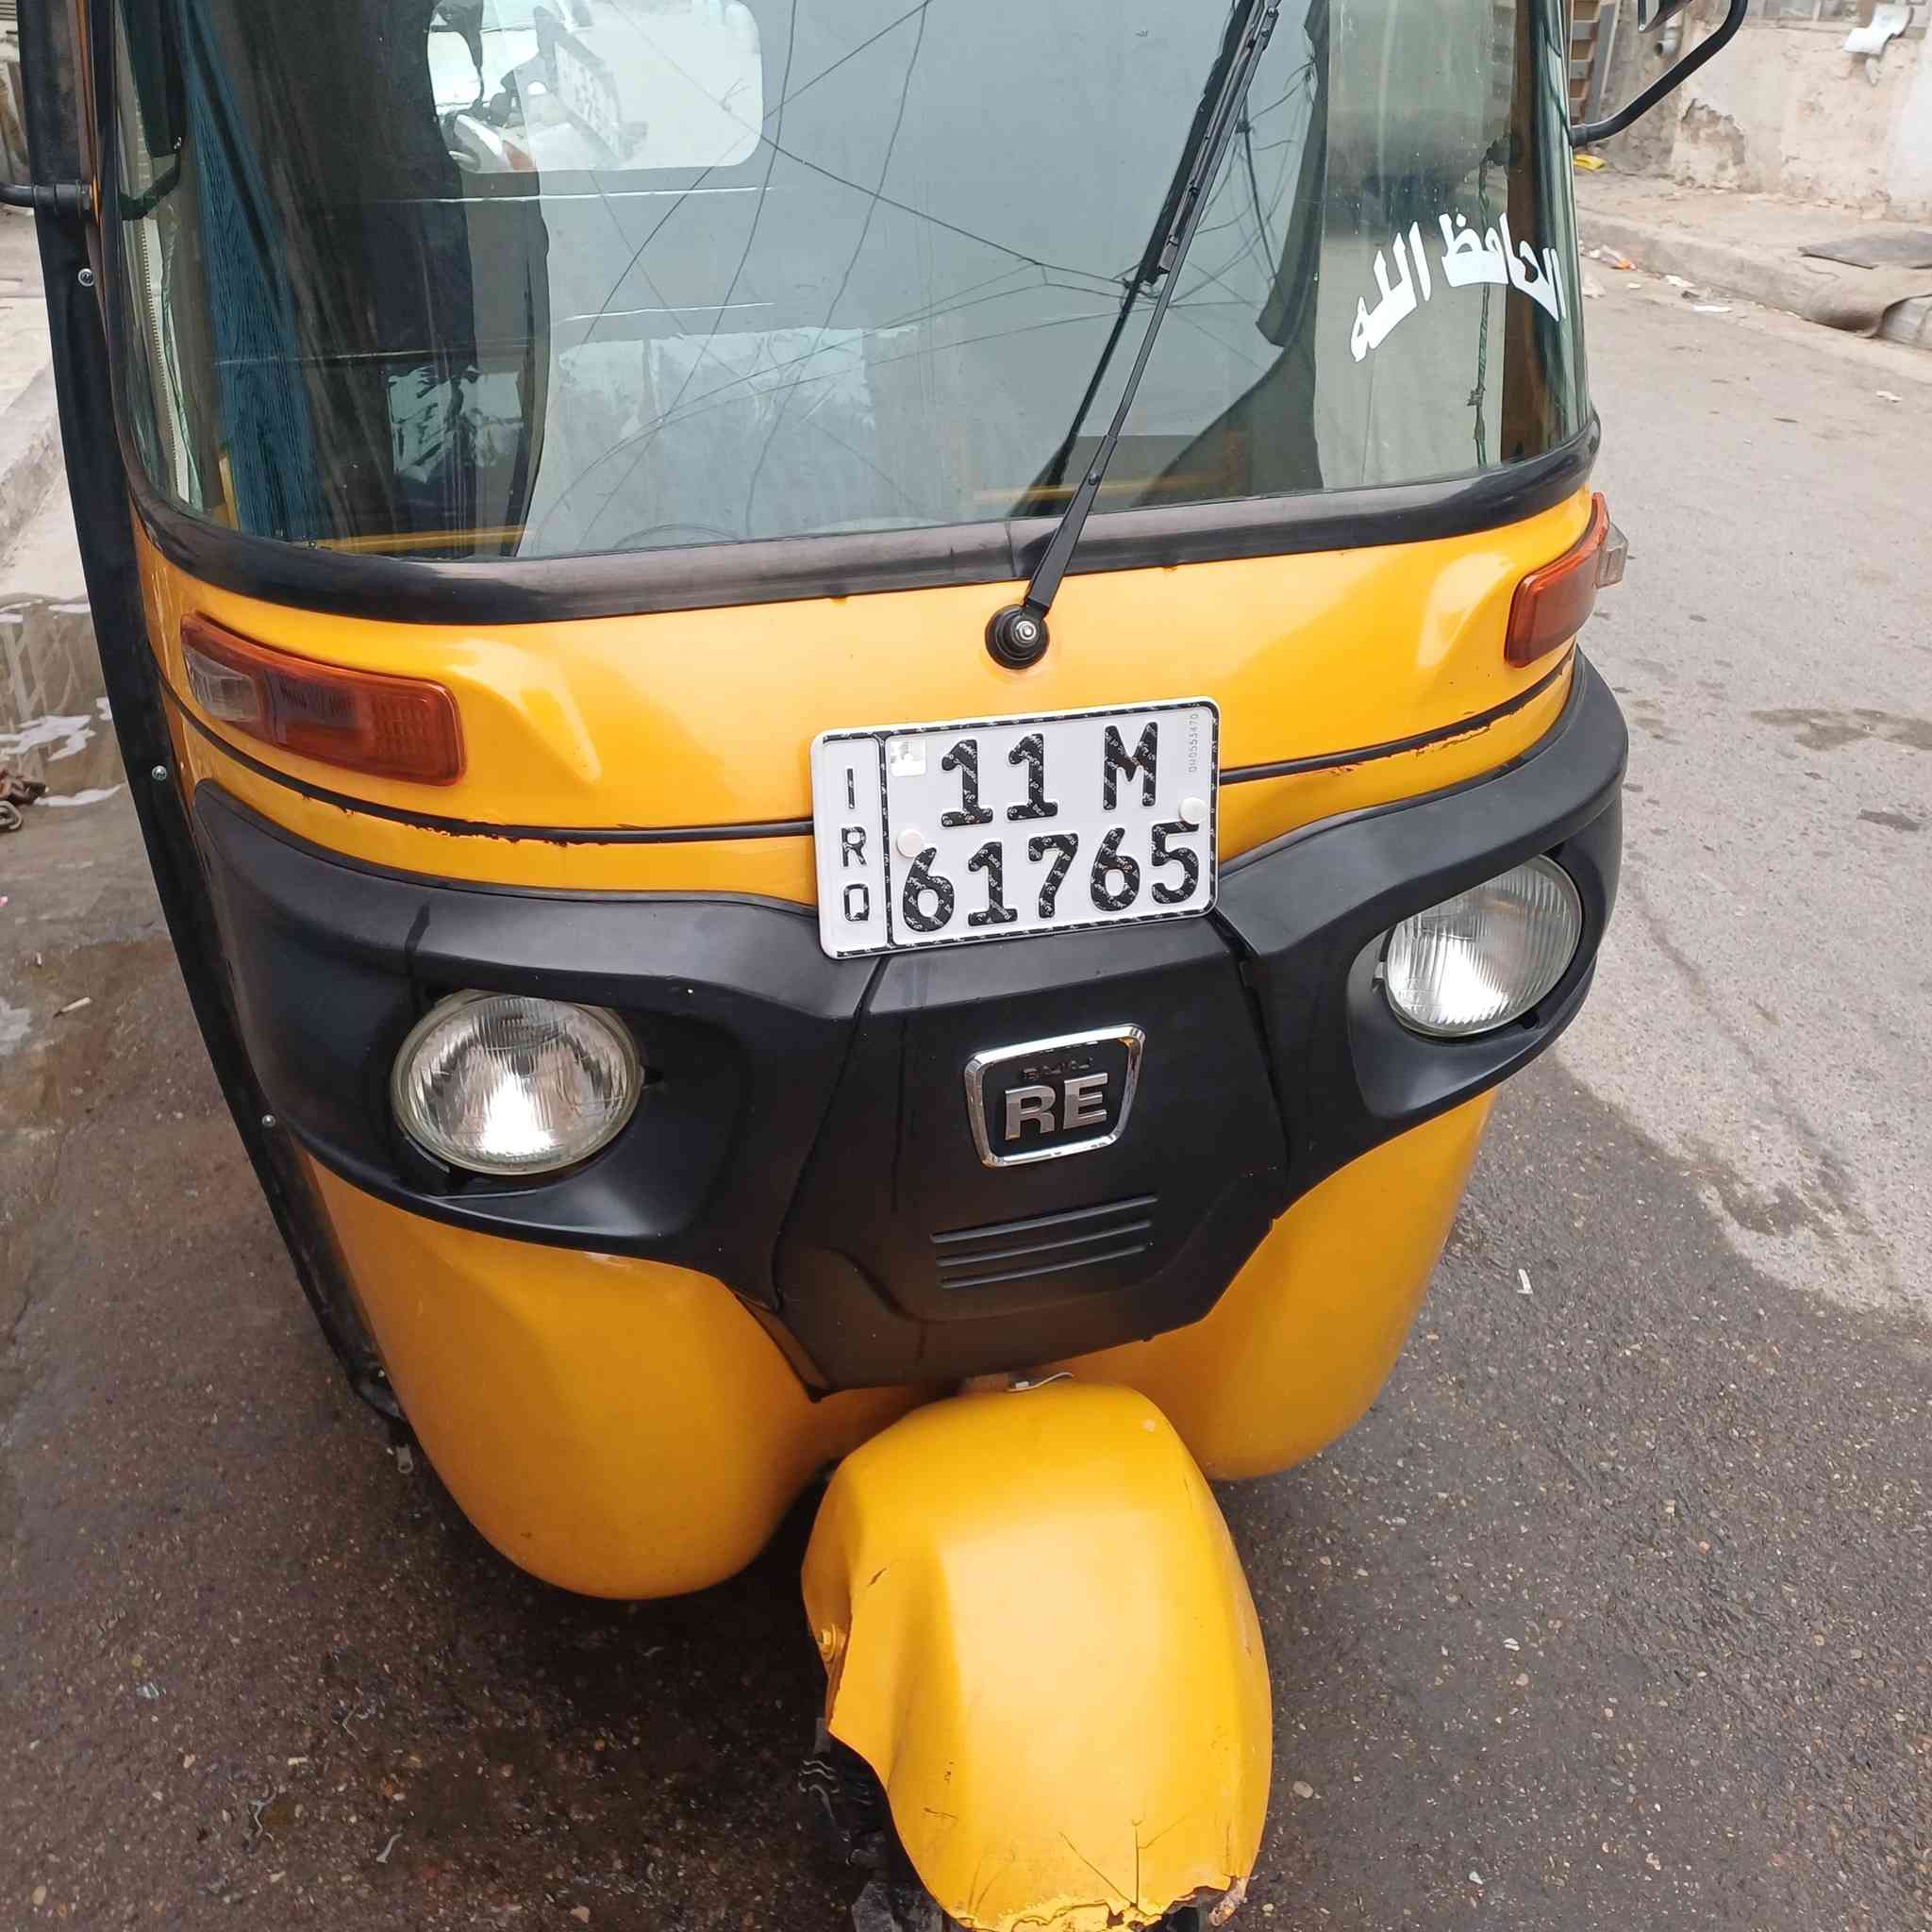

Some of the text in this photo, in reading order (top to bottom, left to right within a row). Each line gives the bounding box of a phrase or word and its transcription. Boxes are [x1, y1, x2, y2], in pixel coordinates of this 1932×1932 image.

[1351, 221, 1431, 362] الله
[941, 722, 1158, 827] 11 M
[903, 822, 1199, 932] 61765
[1004, 1072, 1108, 1141] RE
